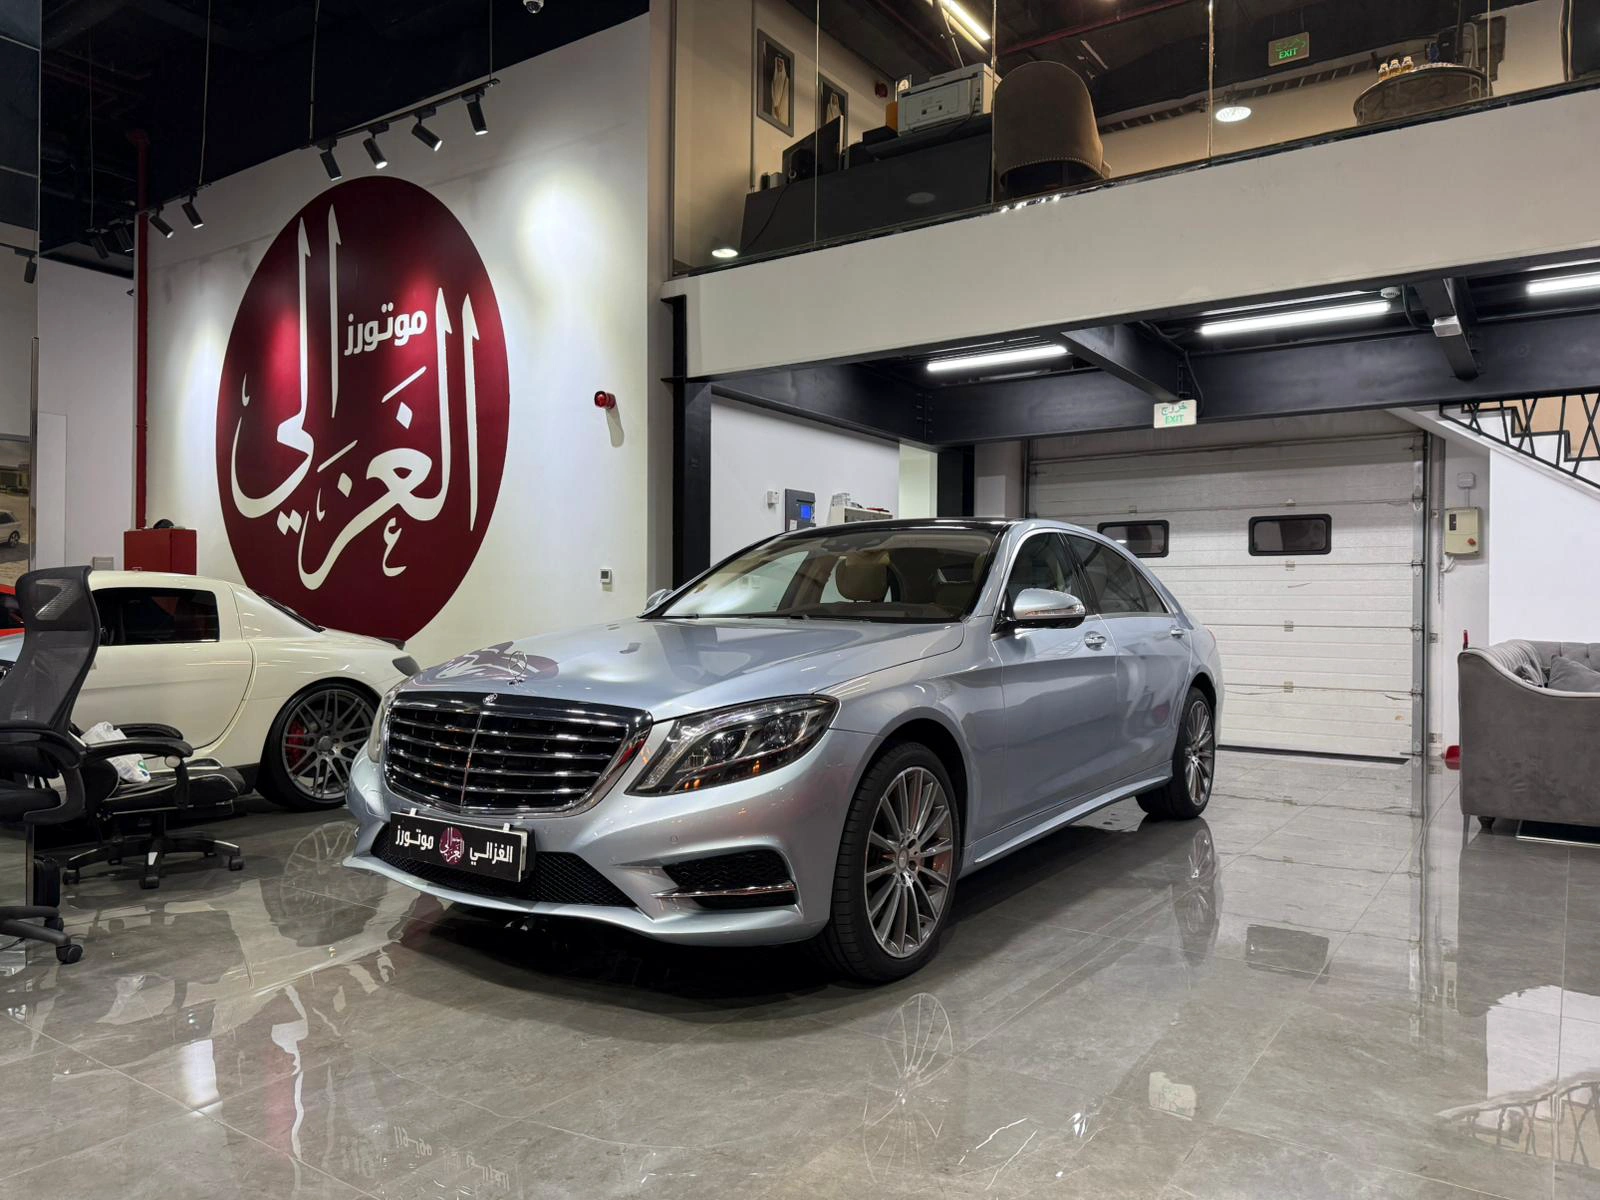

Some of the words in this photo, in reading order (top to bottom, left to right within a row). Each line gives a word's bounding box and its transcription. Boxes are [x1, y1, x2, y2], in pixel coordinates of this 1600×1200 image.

[1279, 47, 1298, 59] EXIT
[343, 302, 427, 356] موتورز
[1165, 414, 1184, 424] EXIT
[395, 825, 434, 851] موتورز
[469, 841, 514, 865] الغزالي
